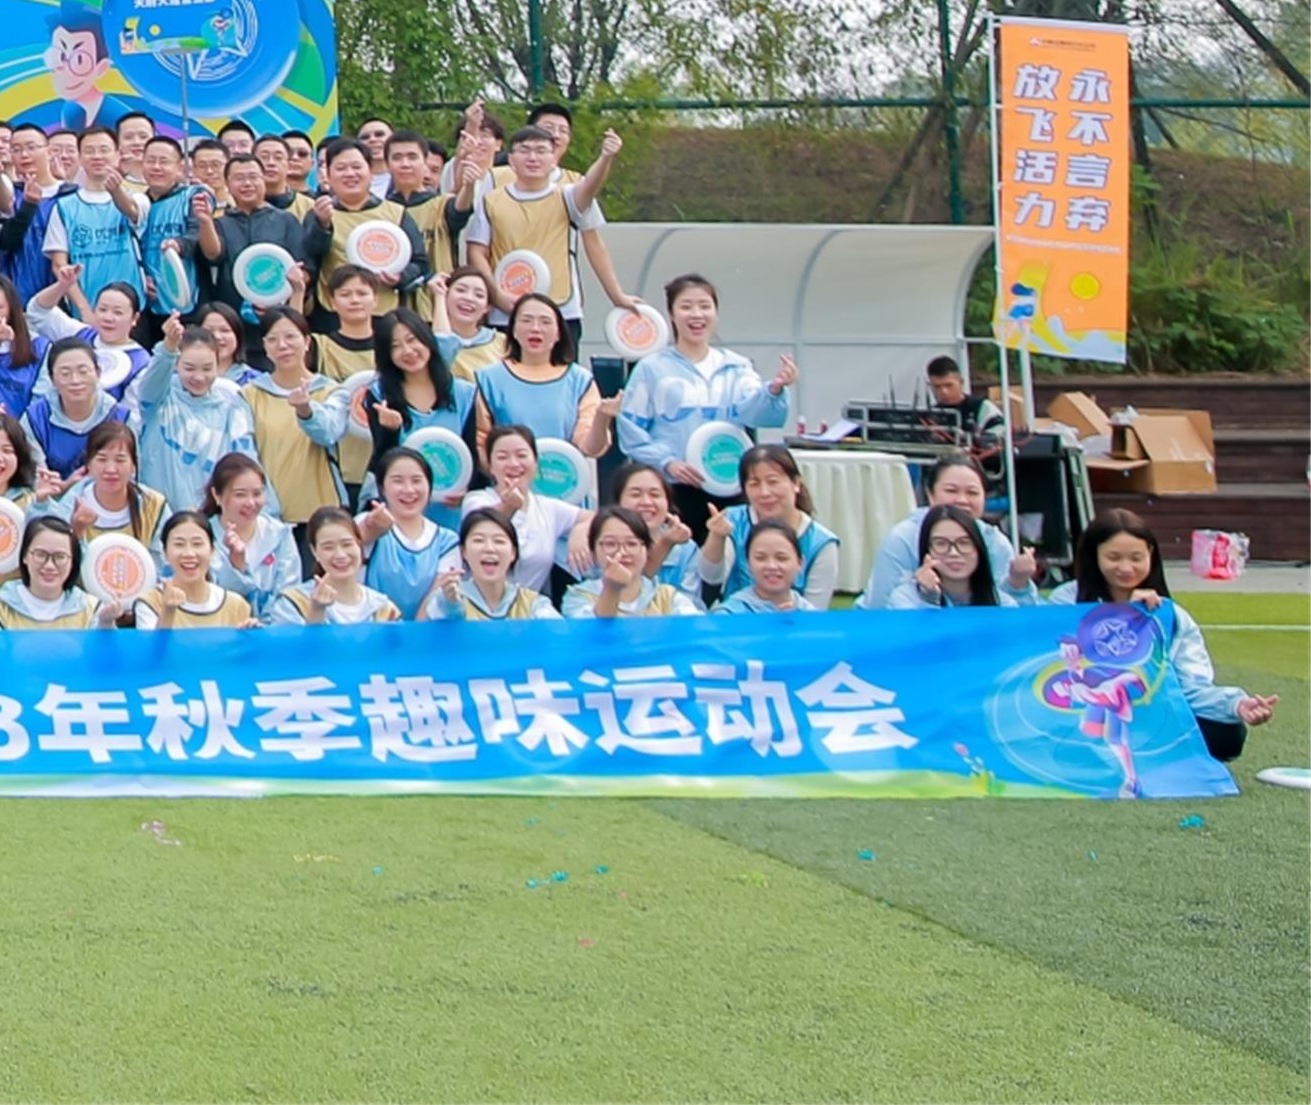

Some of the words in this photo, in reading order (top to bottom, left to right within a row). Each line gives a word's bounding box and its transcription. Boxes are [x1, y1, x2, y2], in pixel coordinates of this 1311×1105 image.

[1012, 63, 1061, 229] 放飞活力
[1065, 67, 1113, 233] 永不言弃
